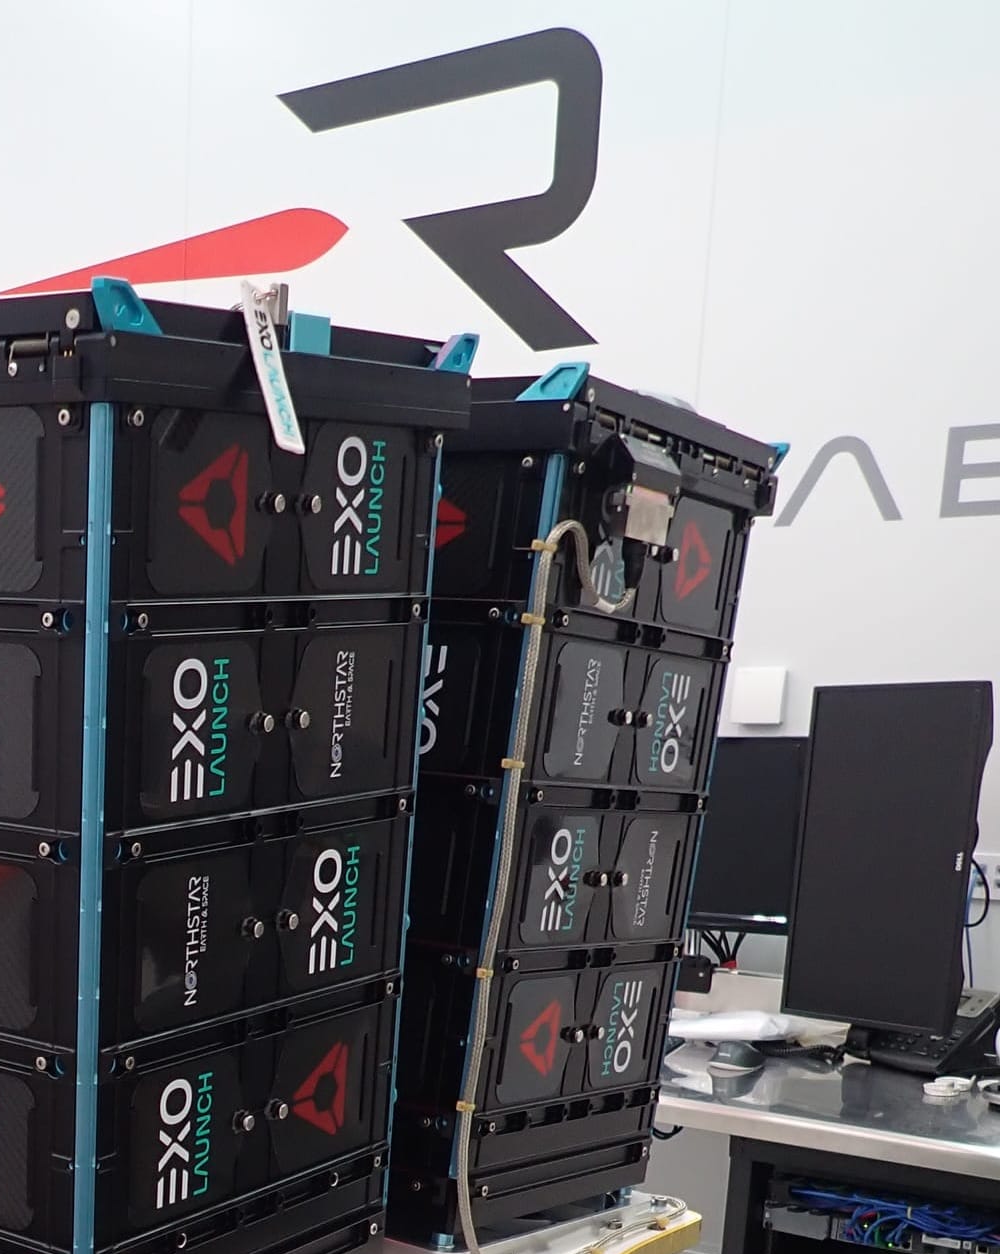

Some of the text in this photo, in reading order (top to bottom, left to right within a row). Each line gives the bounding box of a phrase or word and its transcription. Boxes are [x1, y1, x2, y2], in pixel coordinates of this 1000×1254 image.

[331, 436, 367, 575] EXO
[364, 440, 386, 575] LAUNCH
[170, 658, 208, 802] EXO
[209, 658, 231, 797] LAUNCH
[330, 651, 349, 777] NORTHSTAR
[660, 673, 691, 773] EXO
[184, 876, 201, 1006] NORTHSTAR
[308, 848, 342, 974] EXO
[340, 845, 360, 967] LAUNCH
[610, 981, 643, 1073] EXO
[156, 1078, 193, 1209] EXO
[193, 1072, 213, 1196] LAUNCH
